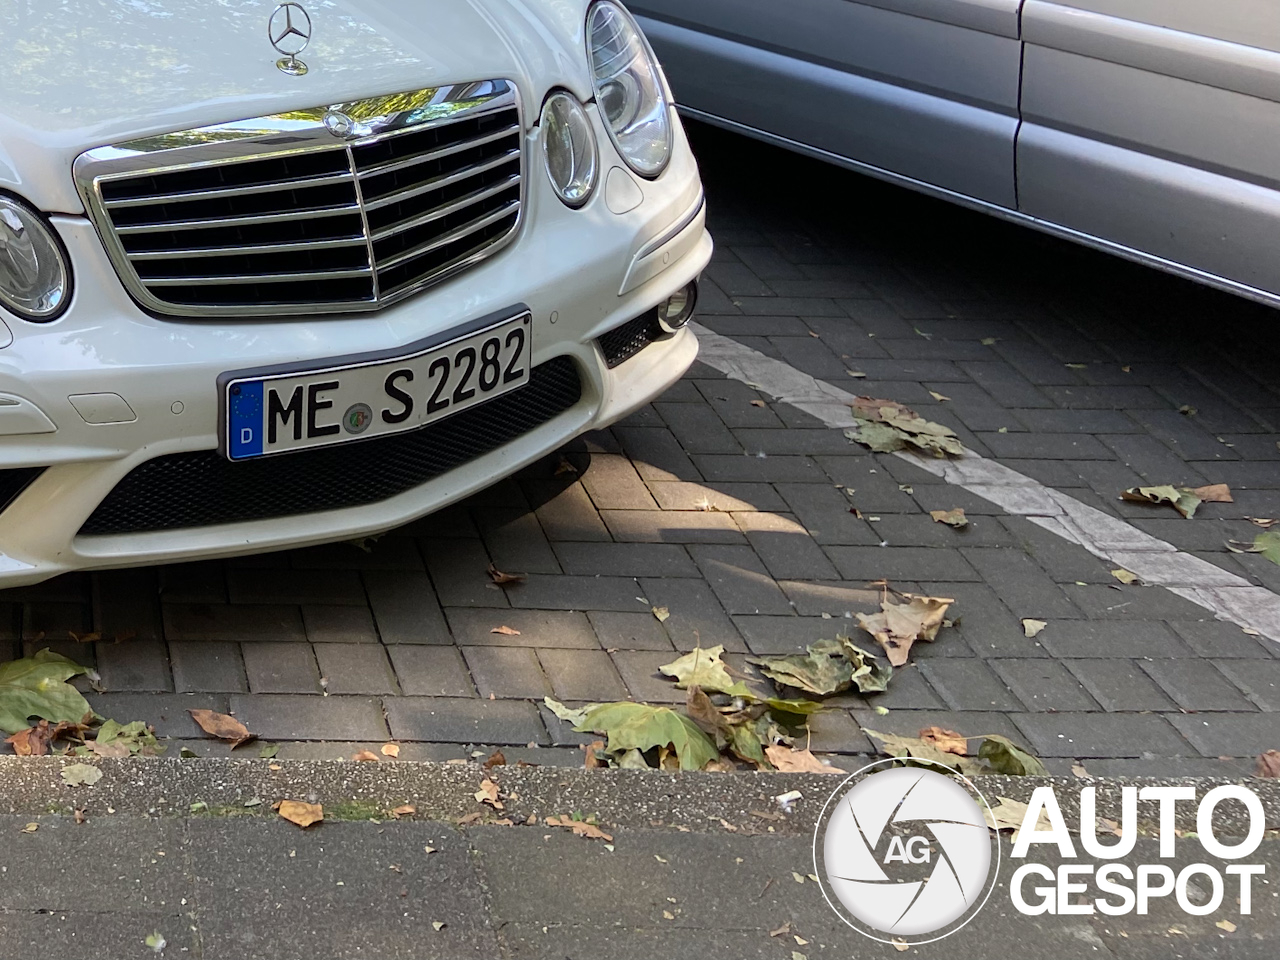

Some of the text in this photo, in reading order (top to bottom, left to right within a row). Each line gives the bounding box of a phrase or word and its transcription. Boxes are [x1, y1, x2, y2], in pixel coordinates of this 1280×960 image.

[241, 428, 253, 444] D
[267, 381, 340, 444] ME
[381, 368, 414, 424] S
[426, 327, 525, 415] 2282
